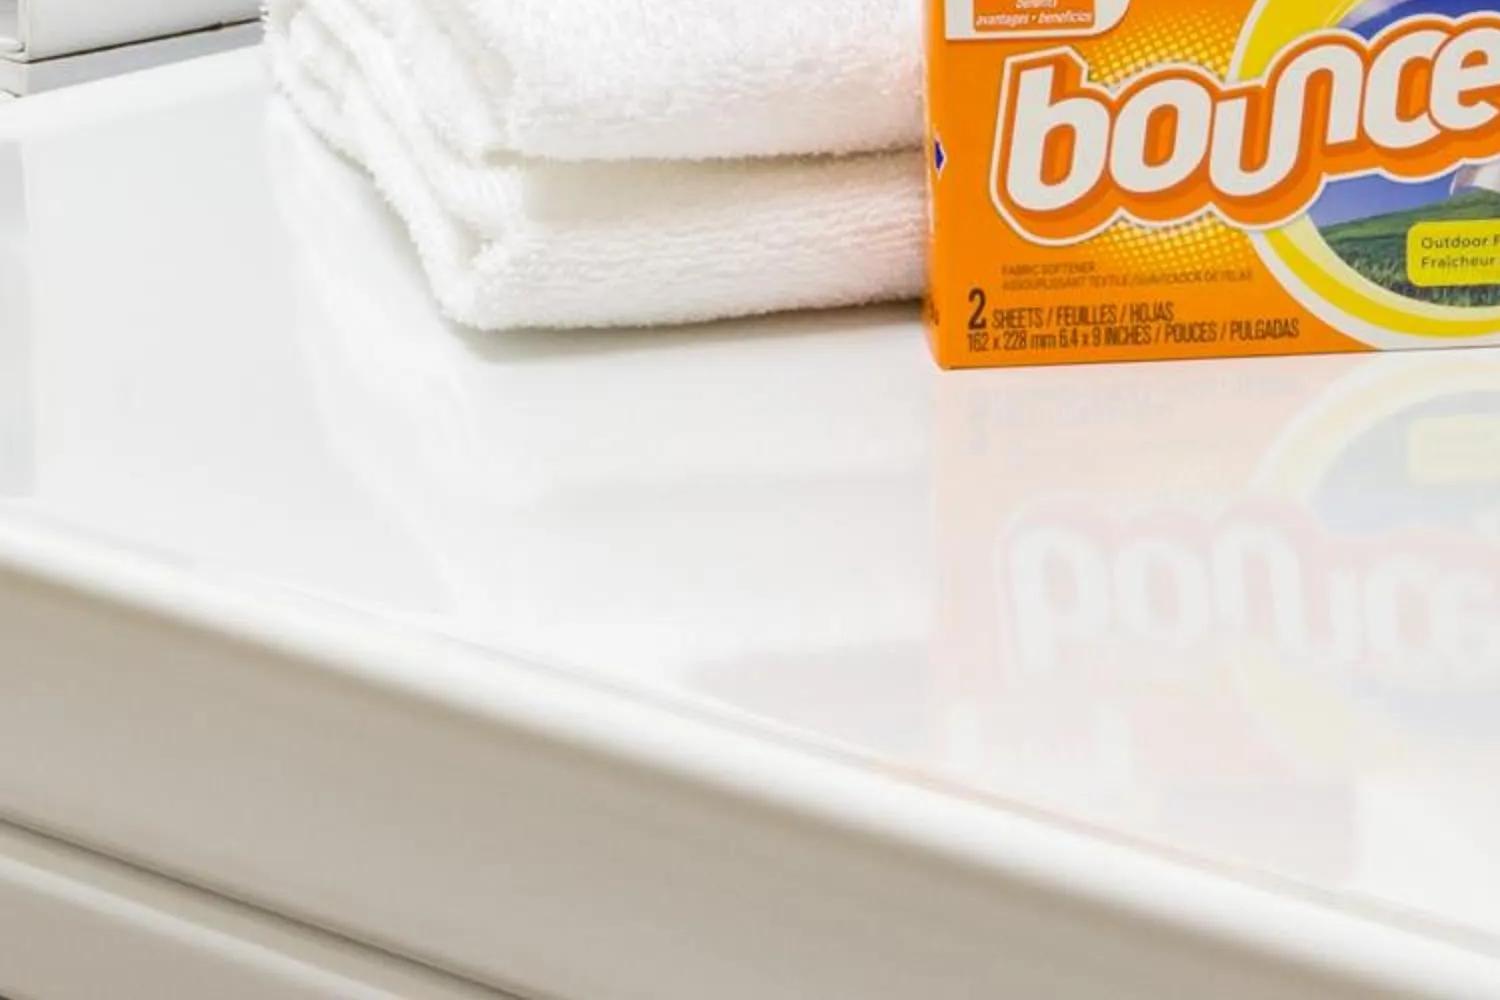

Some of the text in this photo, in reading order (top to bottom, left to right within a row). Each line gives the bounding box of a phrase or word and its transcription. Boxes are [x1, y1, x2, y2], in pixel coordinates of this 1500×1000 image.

[1421, 236, 1488, 249] Outdoor
[1002, 261, 1095, 276] FABRIC SOFTENER
[968, 287, 987, 330] 2
[992, 307, 1044, 329] SHEETS
[1056, 304, 1117, 327] FEUILLES
[1129, 301, 1174, 324] HOJAS
[968, 333, 989, 352] 162
[993, 338, 999, 350] x
[1003, 330, 1027, 350] 228
[1031, 334, 1056, 349] mm
[1082, 333, 1089, 346] x
[1091, 328, 1101, 347] 9
[1104, 324, 1152, 345] INCHES
[1165, 321, 1217, 343] POUCES
[1230, 317, 1300, 341] PULGADAS
